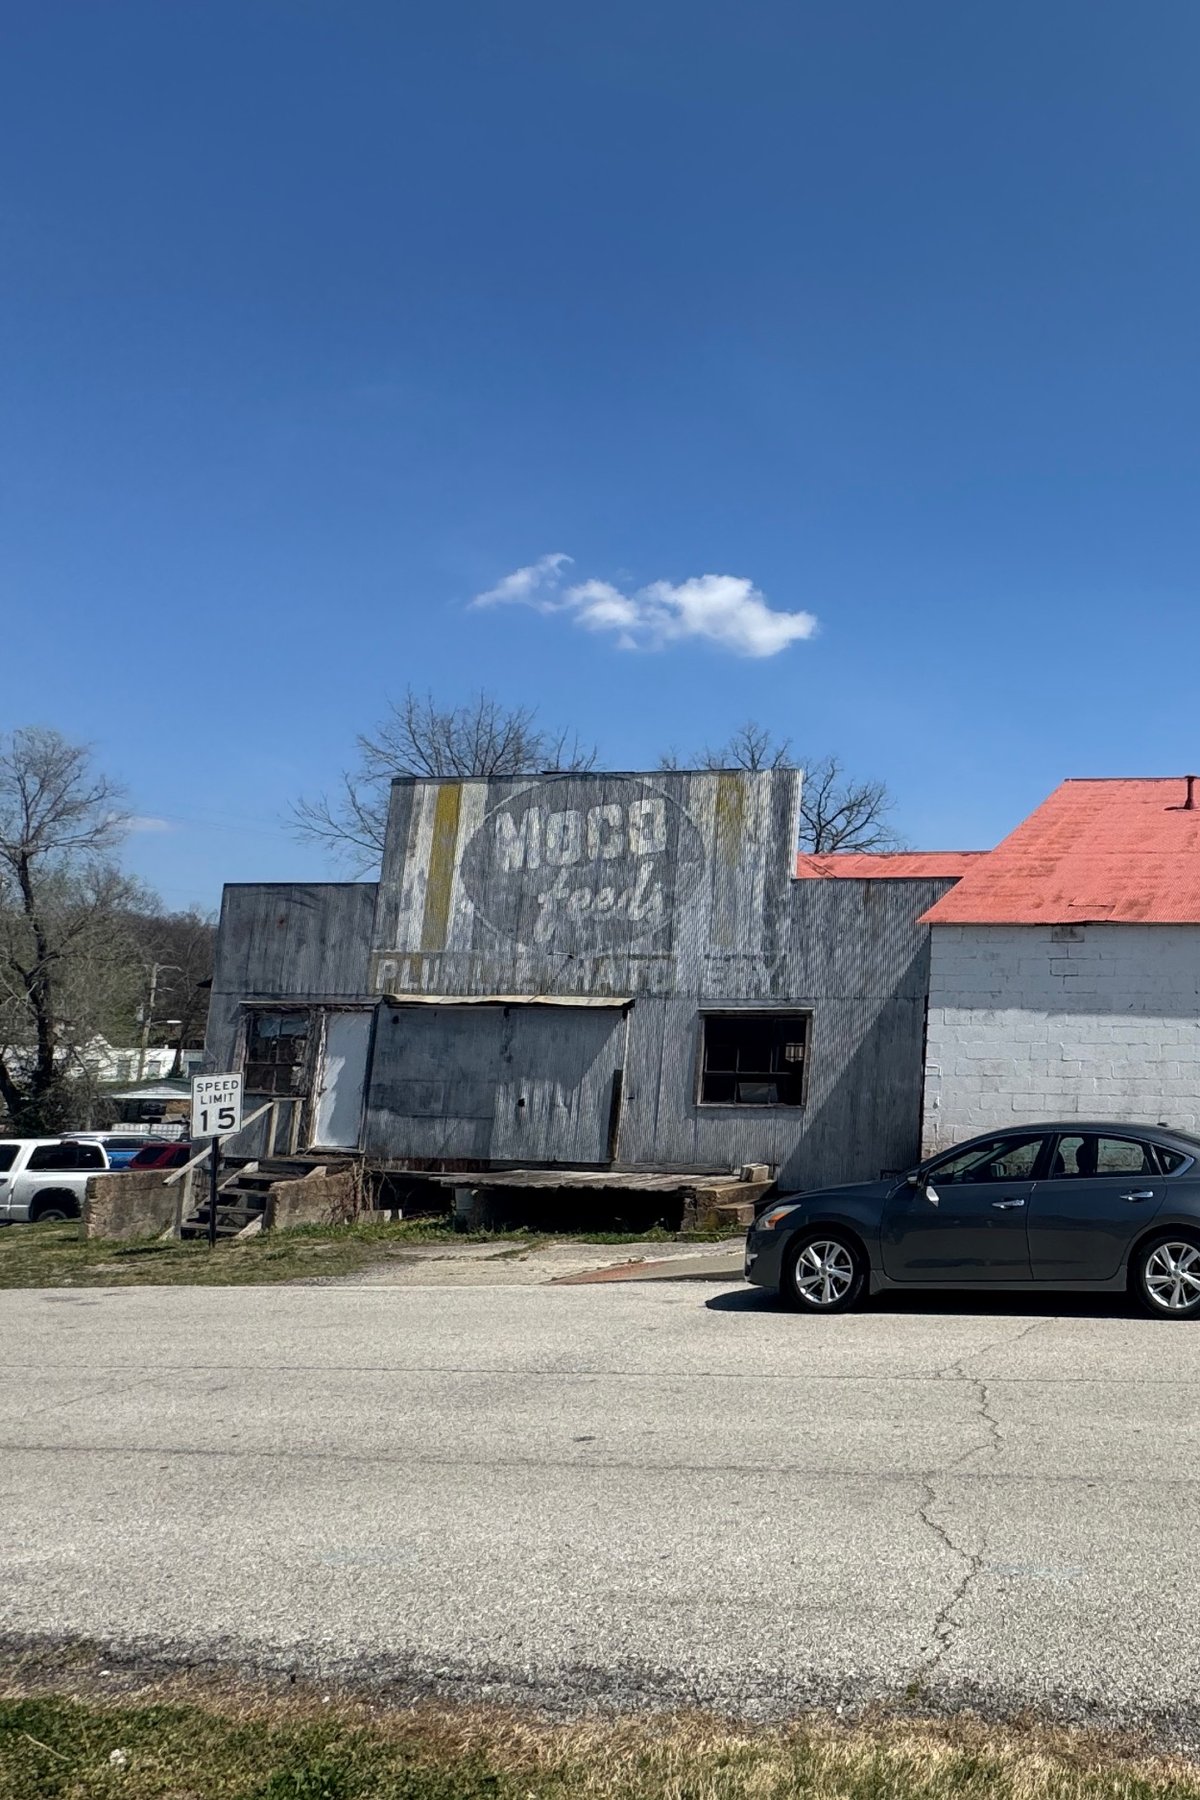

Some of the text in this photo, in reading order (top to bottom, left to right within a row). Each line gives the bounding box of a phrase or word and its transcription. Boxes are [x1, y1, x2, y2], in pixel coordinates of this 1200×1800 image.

[571, 955, 787, 993] HATCERY
[196, 1080, 239, 1093] SPEED
[200, 1093, 235, 1105] LIMIT
[200, 1106, 236, 1132] 15
